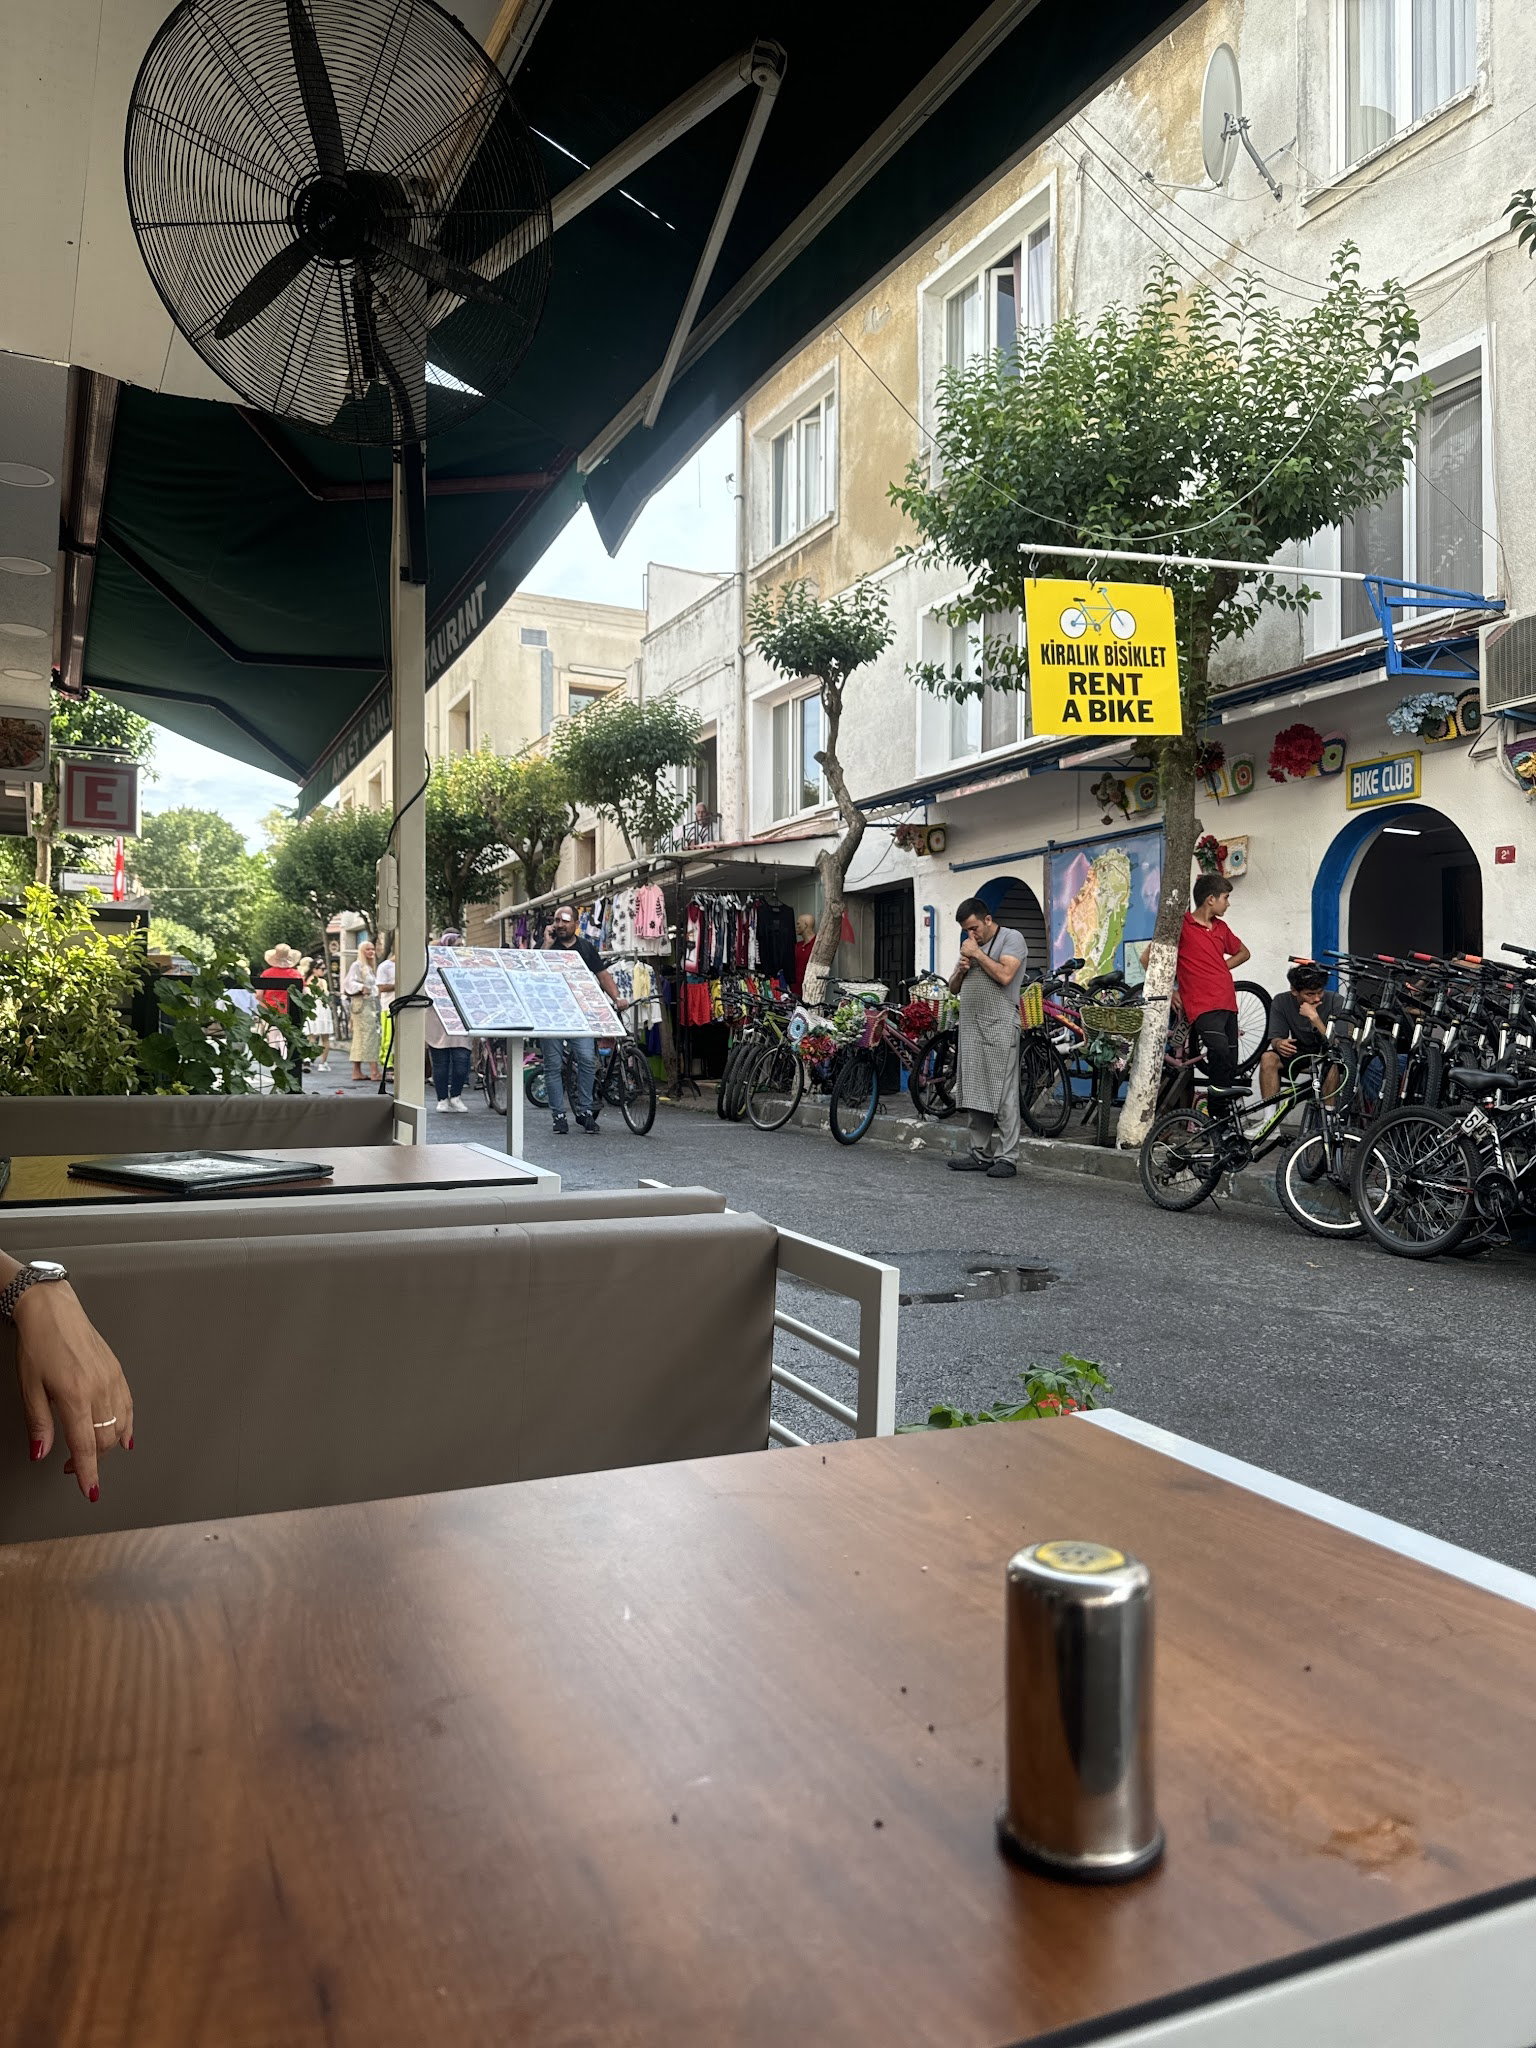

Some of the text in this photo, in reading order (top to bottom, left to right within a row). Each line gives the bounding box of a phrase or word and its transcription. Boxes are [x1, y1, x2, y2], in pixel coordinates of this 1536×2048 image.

[1040, 639, 1166, 668] KİRALIK BİSİKLET
[1068, 672, 1143, 696] RENT
[1062, 699, 1155, 723] A BIKE
[1353, 762, 1413, 798] BIKE CLUB
[84, 775, 117, 820] E
